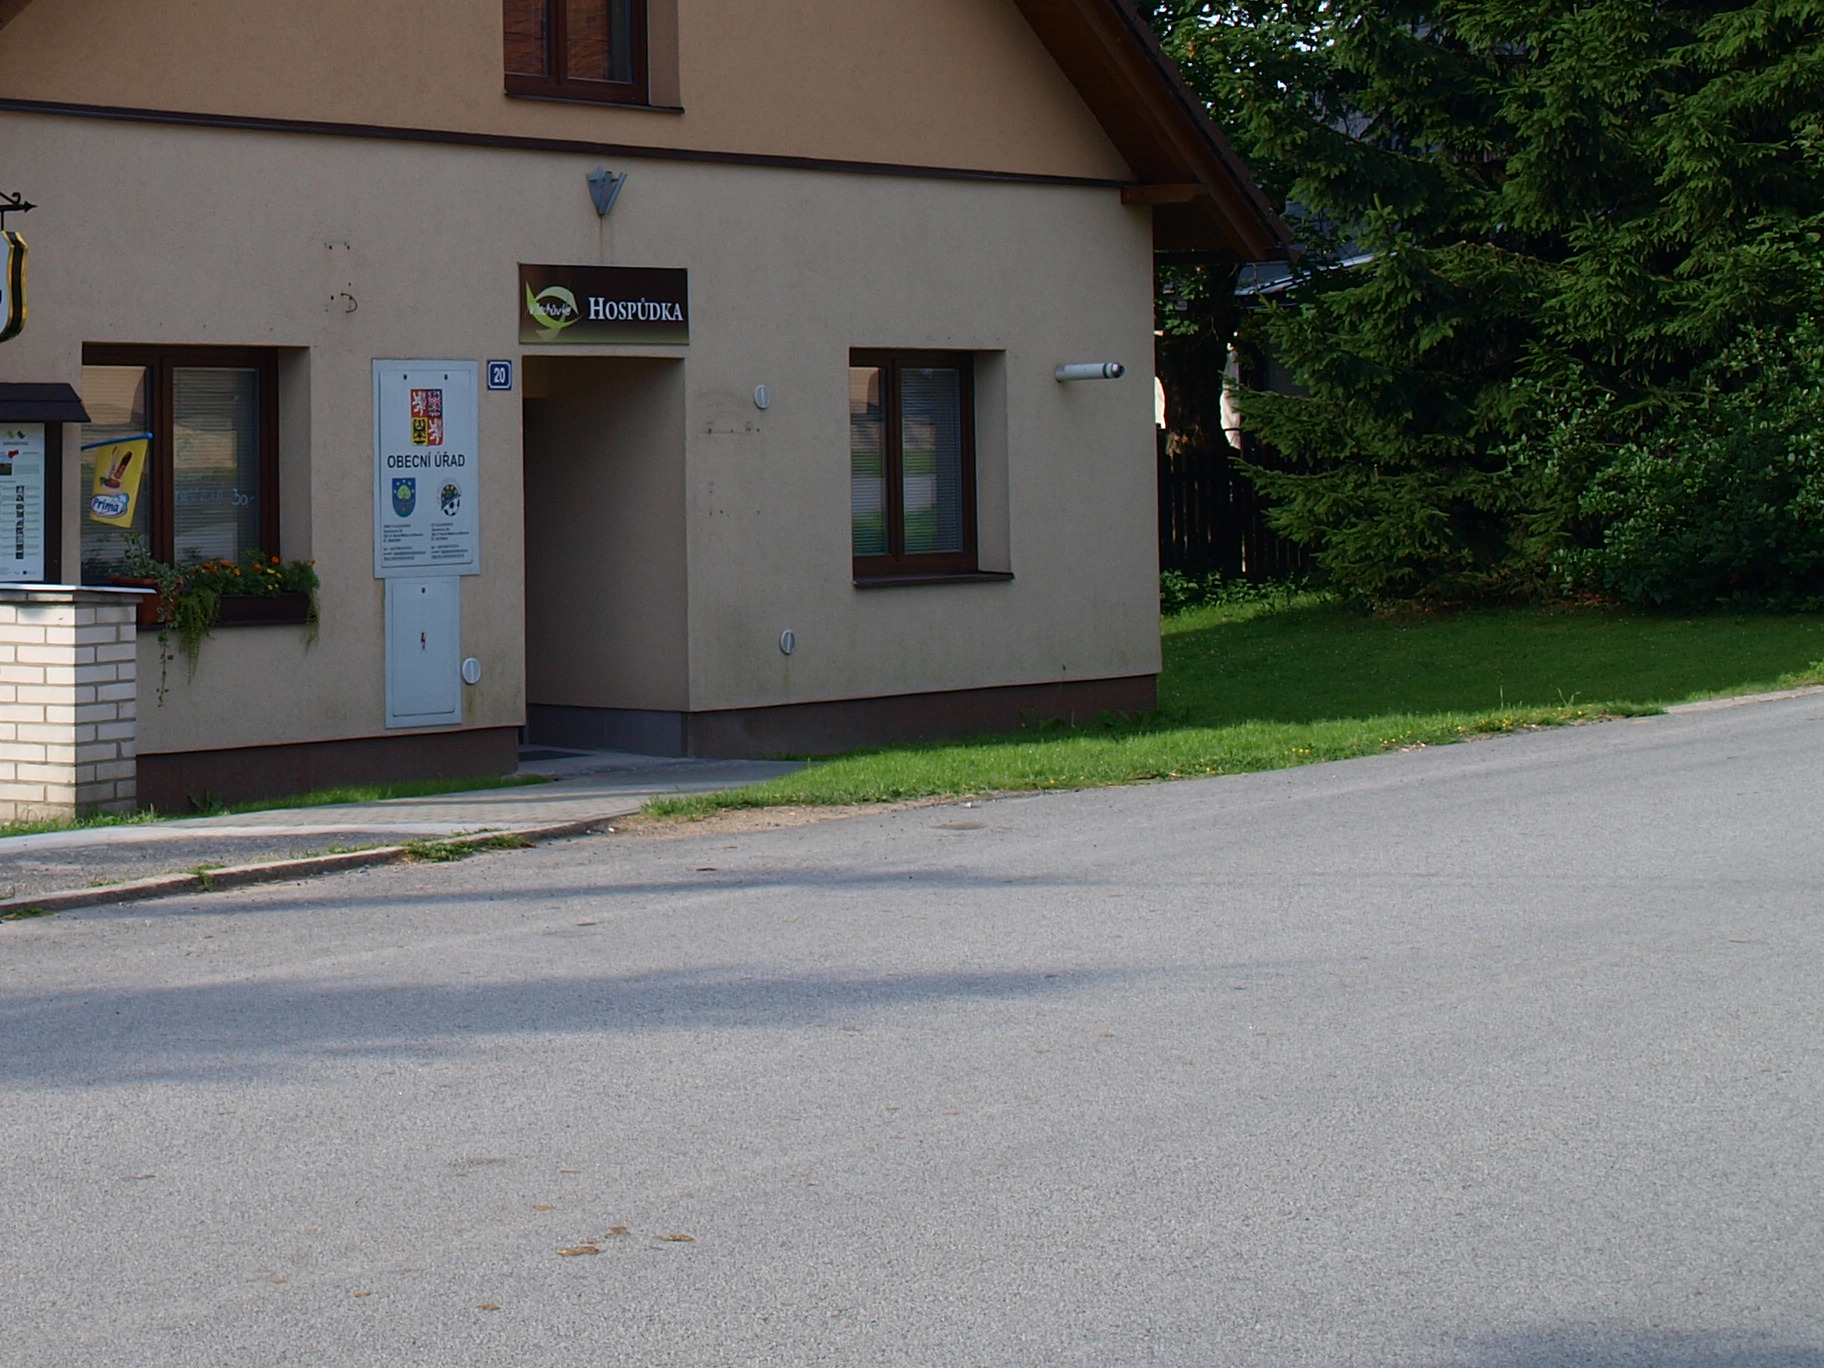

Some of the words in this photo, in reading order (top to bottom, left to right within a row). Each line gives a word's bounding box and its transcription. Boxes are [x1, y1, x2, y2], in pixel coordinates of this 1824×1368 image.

[588, 296, 684, 322] HOSPŮDKA
[493, 367, 506, 383] 20
[387, 452, 431, 468] OBECNÍ
[434, 451, 465, 468] ÚŘAD
[92, 496, 119, 512] Prima
